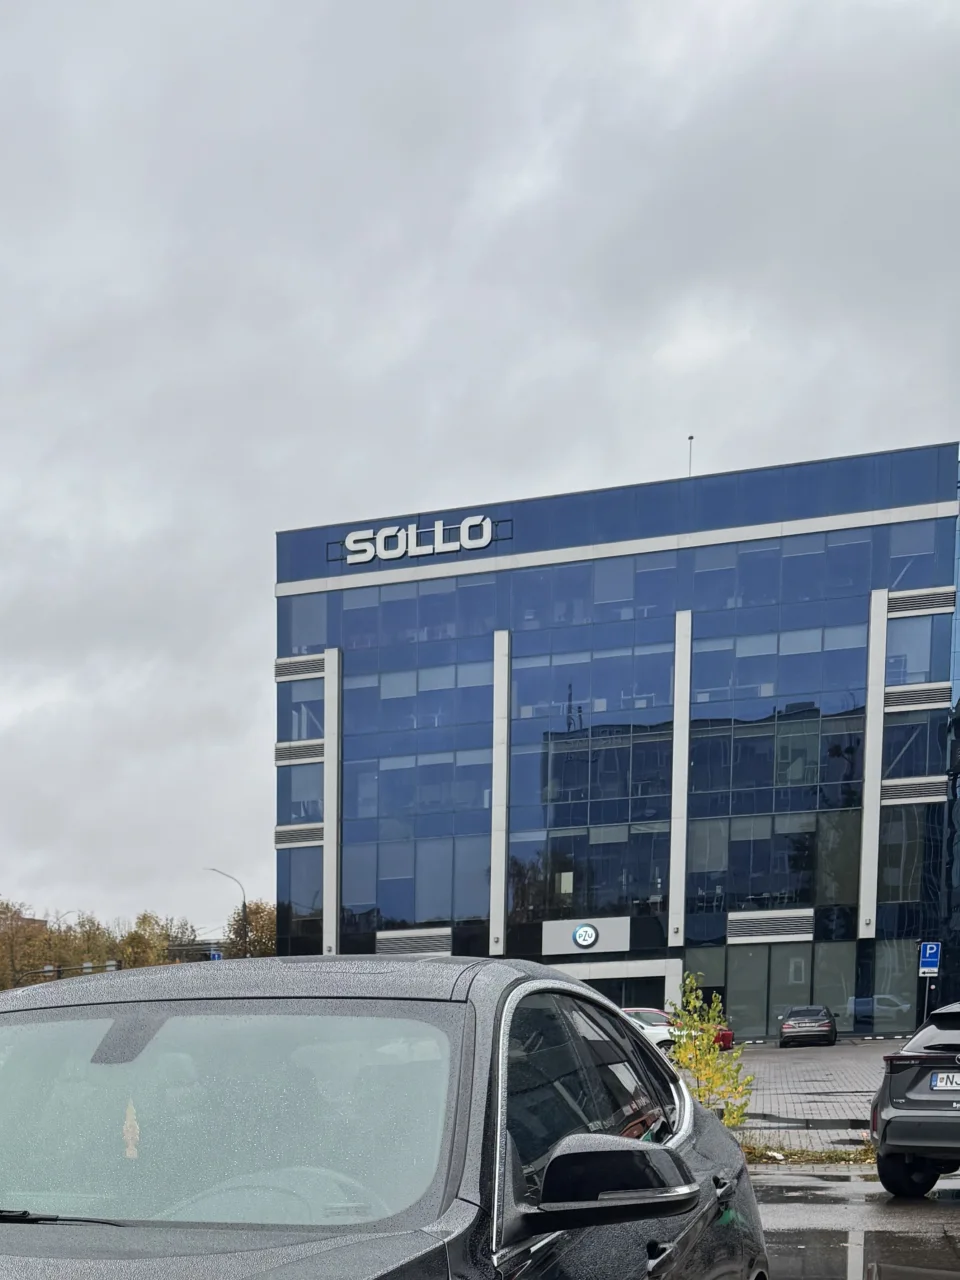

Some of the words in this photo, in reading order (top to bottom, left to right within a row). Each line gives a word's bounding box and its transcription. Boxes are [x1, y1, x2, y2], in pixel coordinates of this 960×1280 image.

[345, 515, 491, 564] SOLLO
[578, 930, 593, 941] PZU
[926, 944, 937, 957] P
